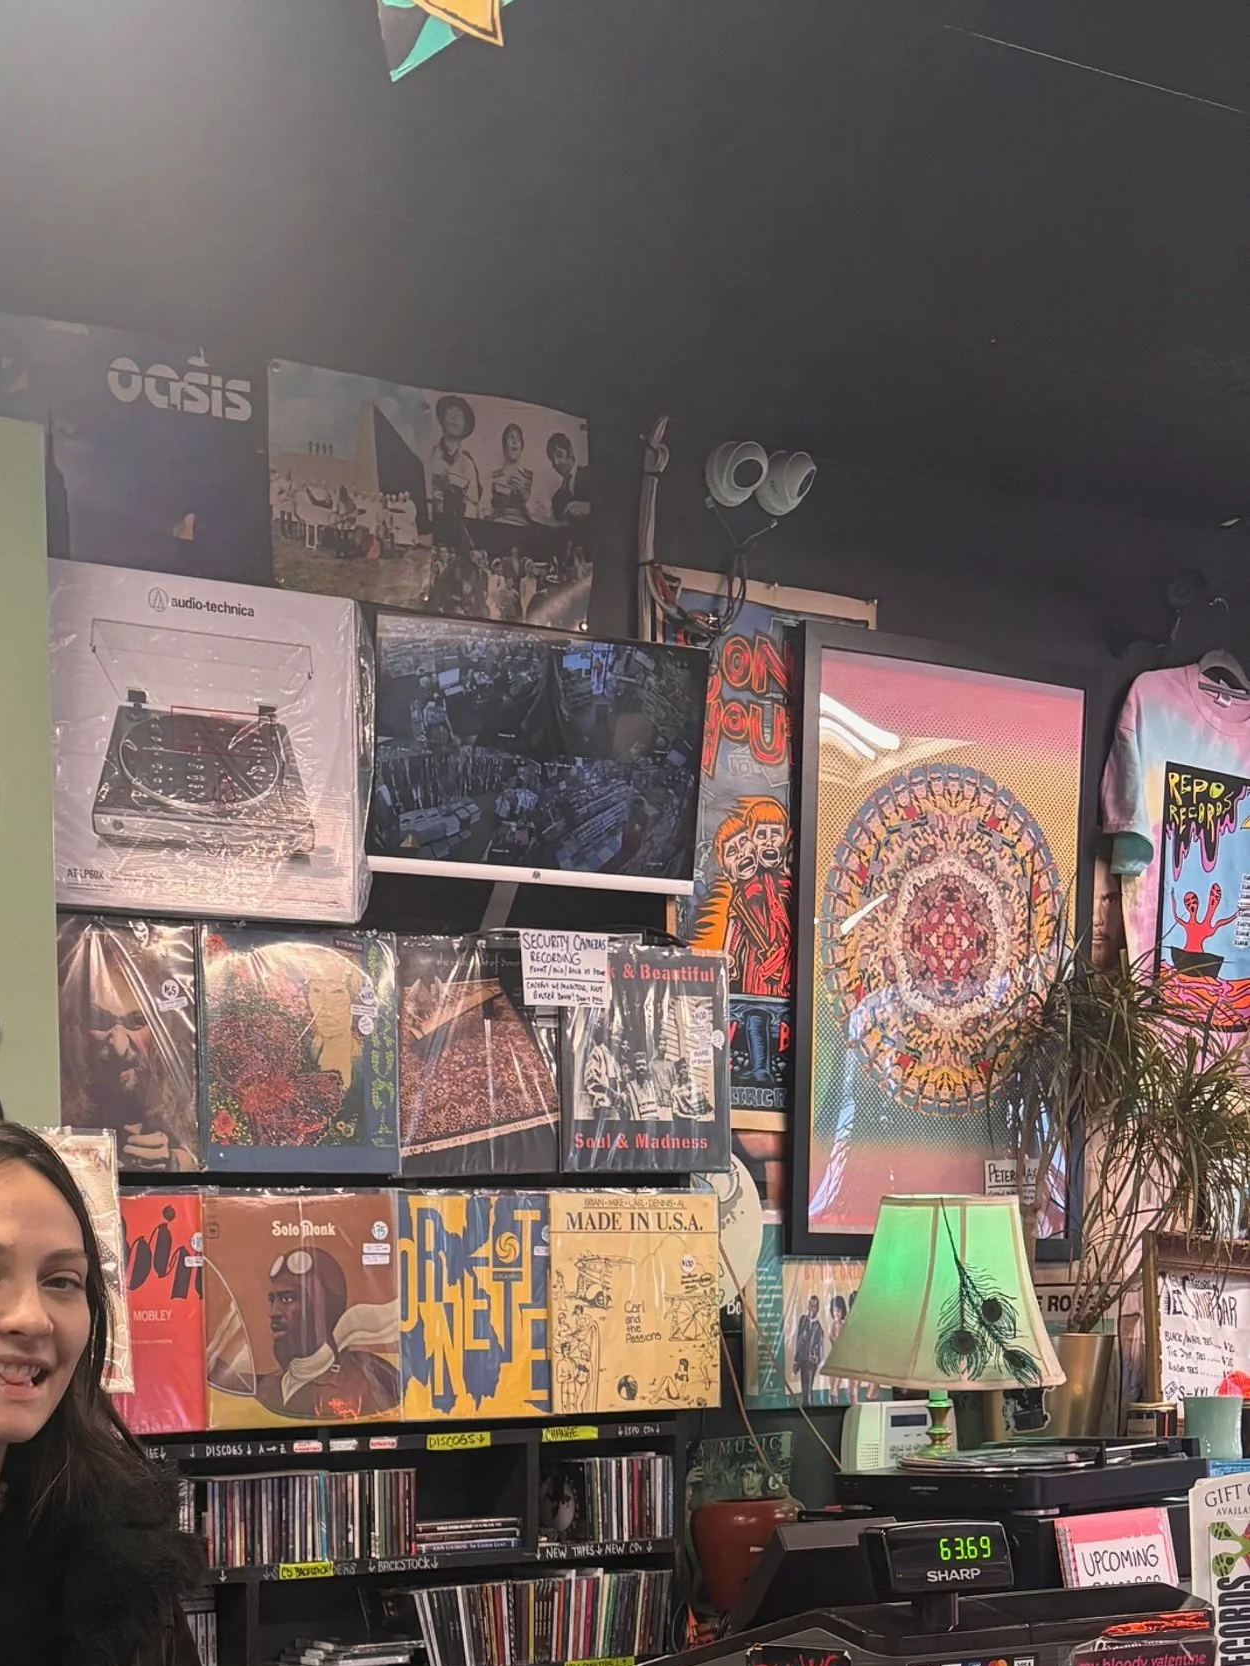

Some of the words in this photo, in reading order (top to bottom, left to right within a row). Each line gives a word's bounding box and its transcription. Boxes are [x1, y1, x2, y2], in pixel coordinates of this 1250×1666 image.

[107, 356, 252, 421] oasis
[171, 597, 255, 617] audio-technica
[1168, 772, 1225, 805] REPO
[1170, 791, 1234, 842] RECORDS
[530, 950, 582, 966] RECORDING
[622, 963, 634, 979] &
[639, 964, 715, 982] Beautiful
[575, 1133, 611, 1150] Soul
[617, 1133, 629, 1149] &
[635, 1133, 708, 1150] Madness
[988, 1163, 1016, 1184] PETER
[271, 1220, 299, 1236] Solo
[300, 1219, 336, 1238] Monk
[566, 1212, 622, 1231] MADE
[630, 1211, 650, 1231] IN
[657, 1211, 704, 1231] U.S.A.
[133, 1309, 172, 1321] MOBLEY
[624, 1300, 645, 1314] Carl
[626, 1314, 641, 1325] and
[626, 1324, 642, 1333] the
[625, 1332, 662, 1345] Passions
[429, 1434, 478, 1449] DISCOGS
[718, 1437, 780, 1454] MUSIC
[205, 1444, 244, 1458] DISCOGS
[1204, 1484, 1244, 1508] GIFT
[546, 1547, 566, 1560] NEW
[573, 1546, 596, 1558] TAPES
[604, 1543, 625, 1555] NEW
[940, 1535, 992, 1561] 63.69
[926, 1567, 982, 1583] SHARP
